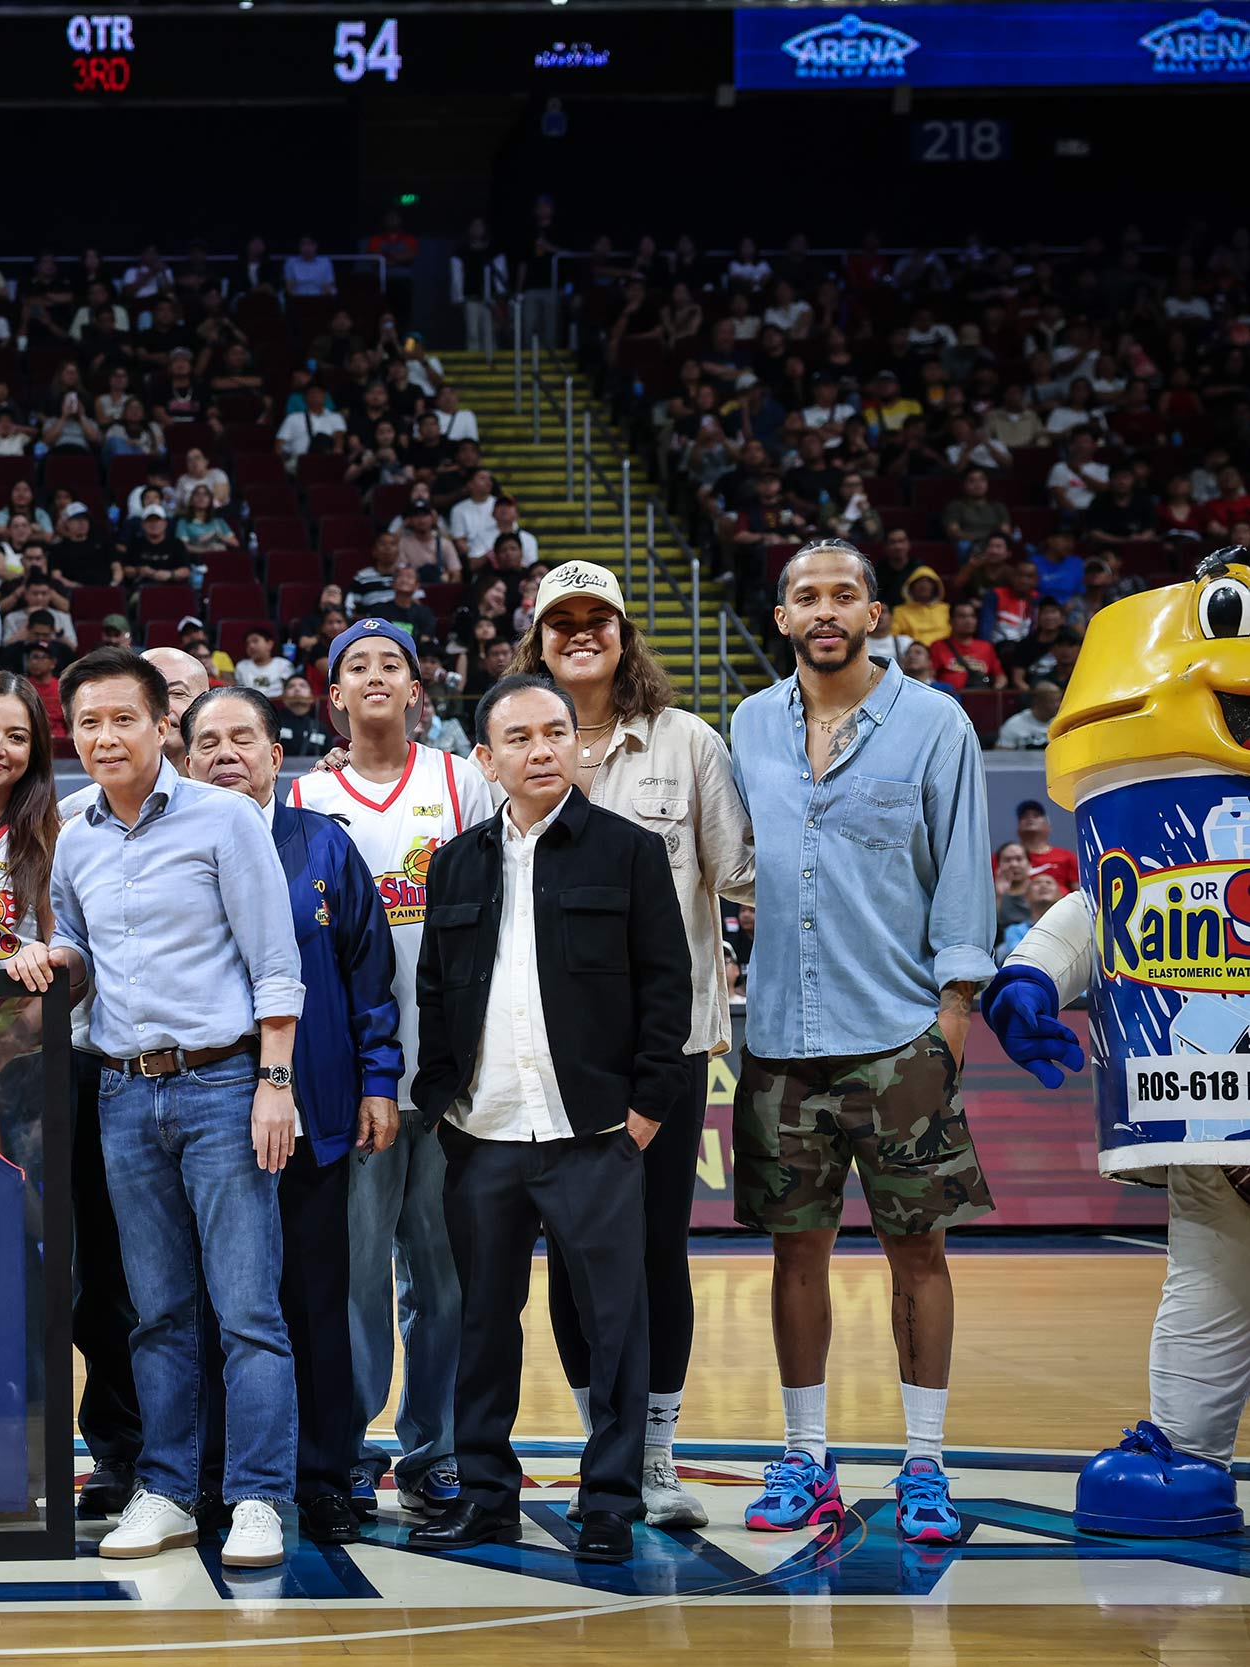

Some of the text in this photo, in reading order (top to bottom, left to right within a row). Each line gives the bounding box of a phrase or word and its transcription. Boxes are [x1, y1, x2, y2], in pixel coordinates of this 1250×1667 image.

[66, 15, 135, 54] QTR
[333, 18, 402, 82] 54
[797, 38, 906, 65] ARENA
[72, 57, 130, 91] 3RD
[922, 120, 1001, 160] 218
[1190, 882, 1218, 900] OR
[1101, 855, 1220, 974] Rain
[1148, 967, 1223, 978] ELASTOMERIC
[1137, 1071, 1239, 1101] ROS-618
